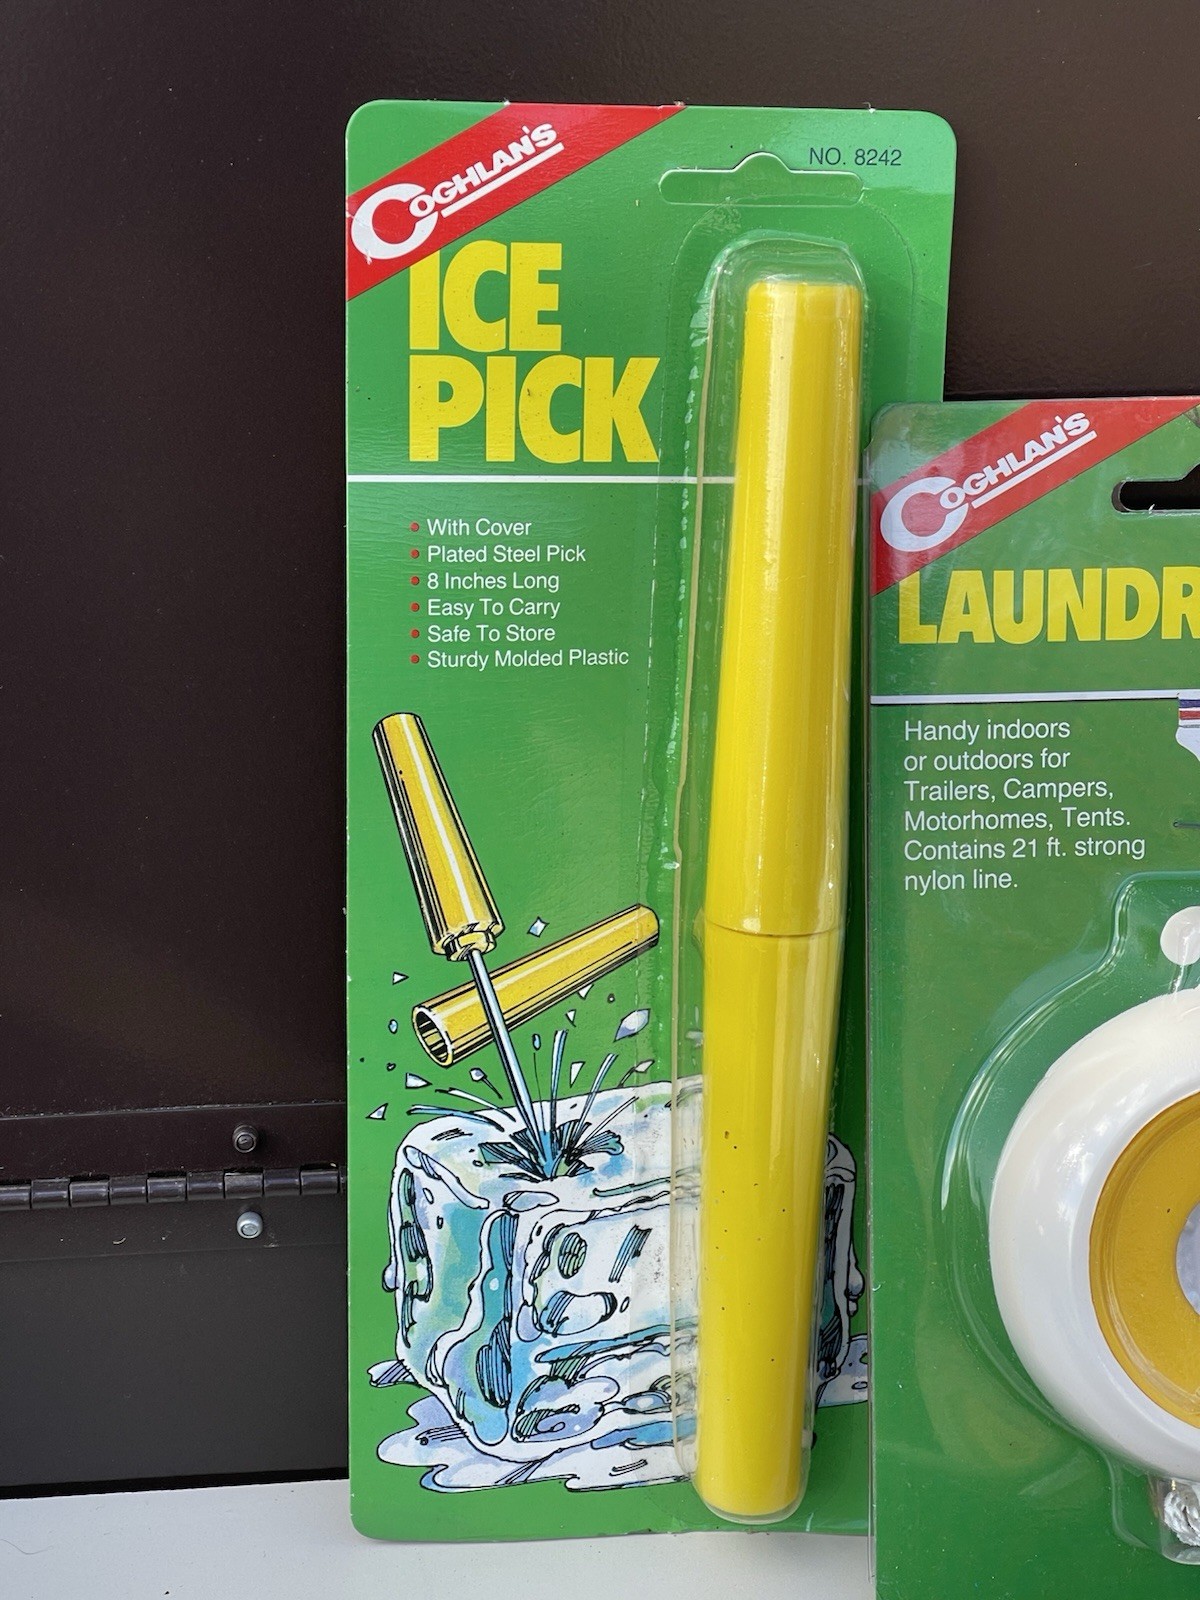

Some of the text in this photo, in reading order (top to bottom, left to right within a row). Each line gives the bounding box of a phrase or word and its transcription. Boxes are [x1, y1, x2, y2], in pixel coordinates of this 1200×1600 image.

[808, 147, 902, 167] NO. 8242
[351, 122, 558, 261] COGHLAN'S
[410, 240, 562, 352] ICE
[409, 355, 660, 463] PICK
[880, 411, 1092, 552] COGHLAN'S
[427, 518, 531, 536] With Cover
[428, 545, 586, 562] Plated Steel Pick
[428, 572, 559, 593] 8 Inches Long
[428, 598, 560, 620] Easy To Carry
[428, 624, 555, 642] Safe To Store
[428, 649, 628, 671] Sturdy Molded Plastic
[906, 719, 1070, 745] Handy indoors
[904, 748, 1070, 771] or outdoors for
[904, 778, 1113, 803] Trailers, Campers,
[905, 807, 1130, 831] Motorhomes, Tents.
[905, 837, 1145, 860] Contains 21 ft. strong
[905, 869, 1017, 895] nylon line.
